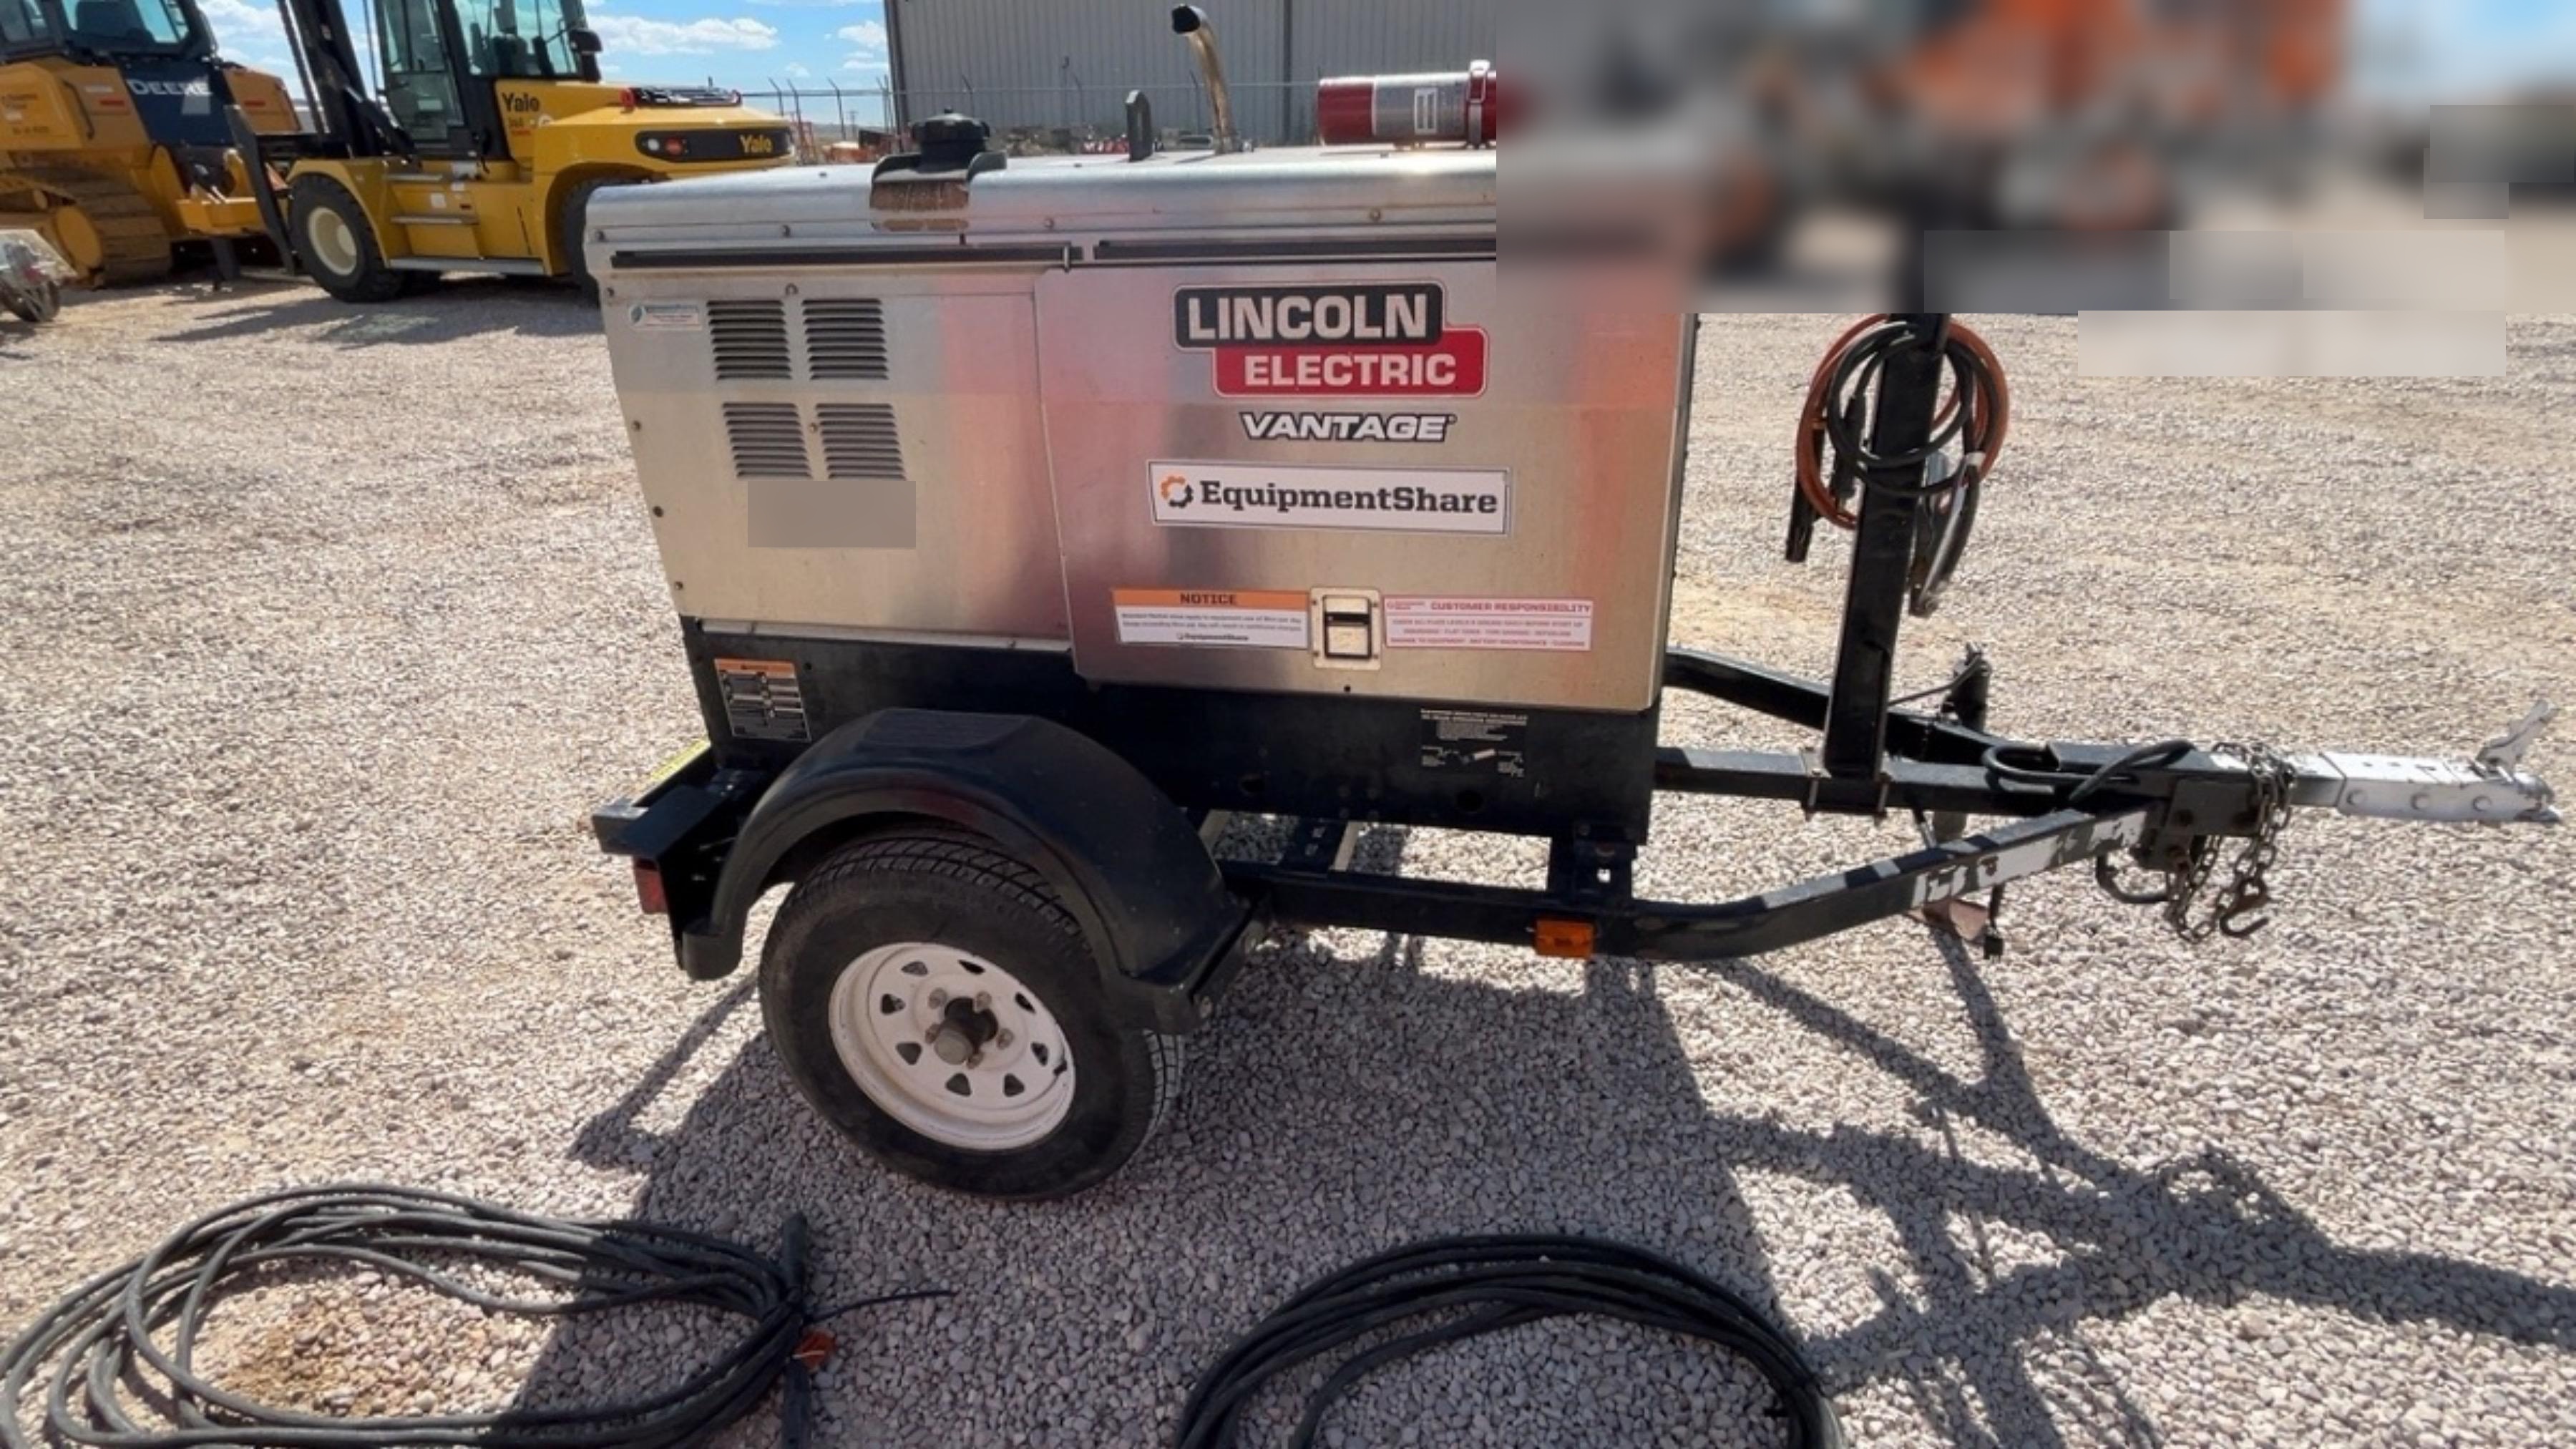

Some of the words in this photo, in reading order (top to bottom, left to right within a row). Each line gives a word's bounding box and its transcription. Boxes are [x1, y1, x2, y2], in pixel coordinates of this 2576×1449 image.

[126, 79, 213, 95] DEERE
[502, 92, 540, 112] Yale
[739, 134, 772, 153] Yale
[1188, 293, 1427, 340] LINCOLN
[1244, 353, 1457, 386] ELECTRIC
[1239, 412, 1447, 441] VANTAGE
[1199, 480, 1498, 514] EquipmentShare
[1180, 593, 1237, 605] NOTICE
[1431, 602, 1492, 611] CUSTOMER
[1493, 602, 1591, 613] RESPONSIBILITY
